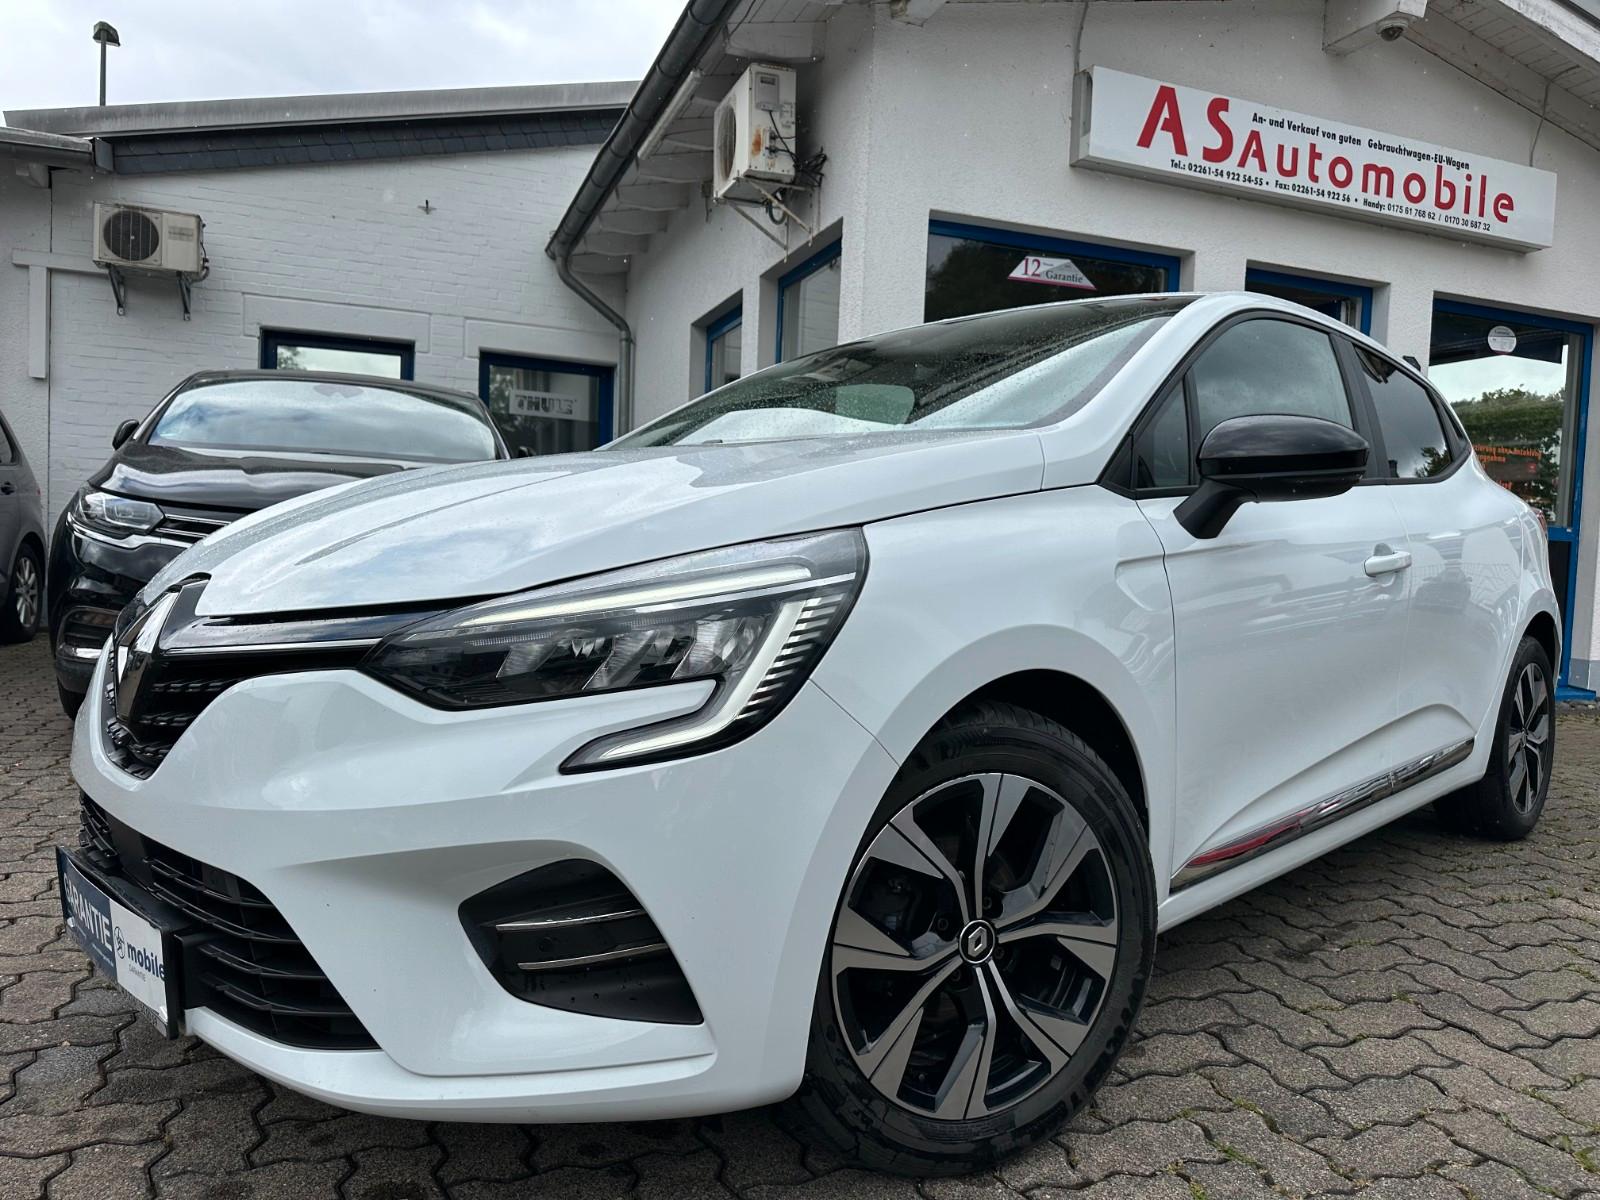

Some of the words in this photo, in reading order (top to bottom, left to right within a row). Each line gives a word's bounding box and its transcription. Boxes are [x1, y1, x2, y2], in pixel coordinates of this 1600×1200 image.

[1252, 112, 1266, 124] An-
[1269, 118, 1285, 129] und
[1287, 119, 1320, 137] Verkauf
[1321, 129, 1337, 140] von
[1338, 133, 1362, 146] guten
[1188, 163, 1224, 178] 02261-54
[1226, 171, 1240, 182] 922
[1242, 174, 1264, 186] 54-55
[1274, 180, 1290, 191] Fax:
[1291, 183, 1325, 198] 02261-54
[1327, 190, 1340, 201] 922
[1341, 193, 1351, 203] 56
[1363, 198, 1386, 212] Handy:
[1387, 203, 1404, 214] 0175
[1404, 206, 1413, 216] 61
[1414, 208, 1426, 219] 768
[1444, 214, 1460, 226] 0170
[1482, 222, 1491, 231] 32
[1022, 257, 1041, 277] 12
[1045, 270, 1083, 283] Garantie
[127, 942, 165, 981] mobile
